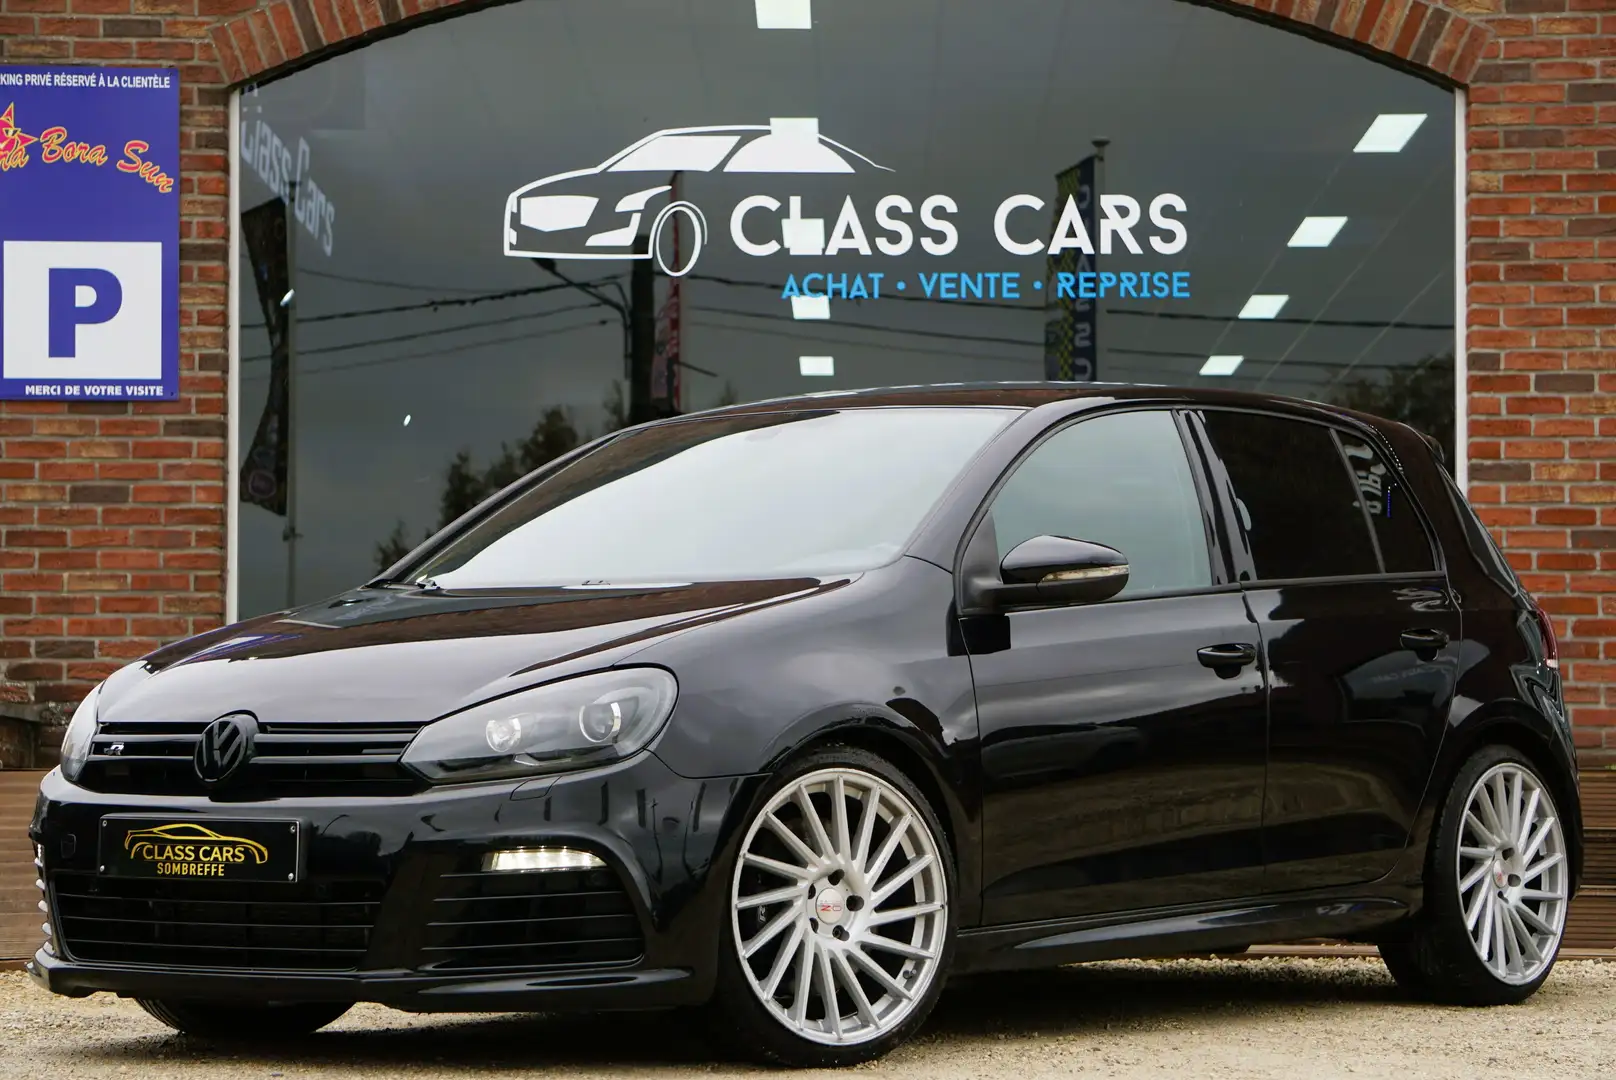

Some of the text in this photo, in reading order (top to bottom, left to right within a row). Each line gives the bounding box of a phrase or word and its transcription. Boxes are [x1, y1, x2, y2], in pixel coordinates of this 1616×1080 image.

[24, 71, 53, 87] PRIVÉ
[54, 72, 97, 87] RÉSERVÉ
[98, 72, 106, 88] À
[107, 75, 120, 88] LA
[120, 74, 171, 89] CLIENTÈLE
[40, 126, 108, 166] Bora
[116, 140, 174, 193] Sun
[730, 193, 1188, 256] CLASS CARS
[781, 271, 1191, 299] ACHAT VENTE REPRISE
[48, 267, 123, 358] P
[25, 385, 164, 397] MERCI DE VOTRE VISITE
[143, 844, 246, 862] CLASS CARS
[157, 862, 225, 877] SOMBREFFE
